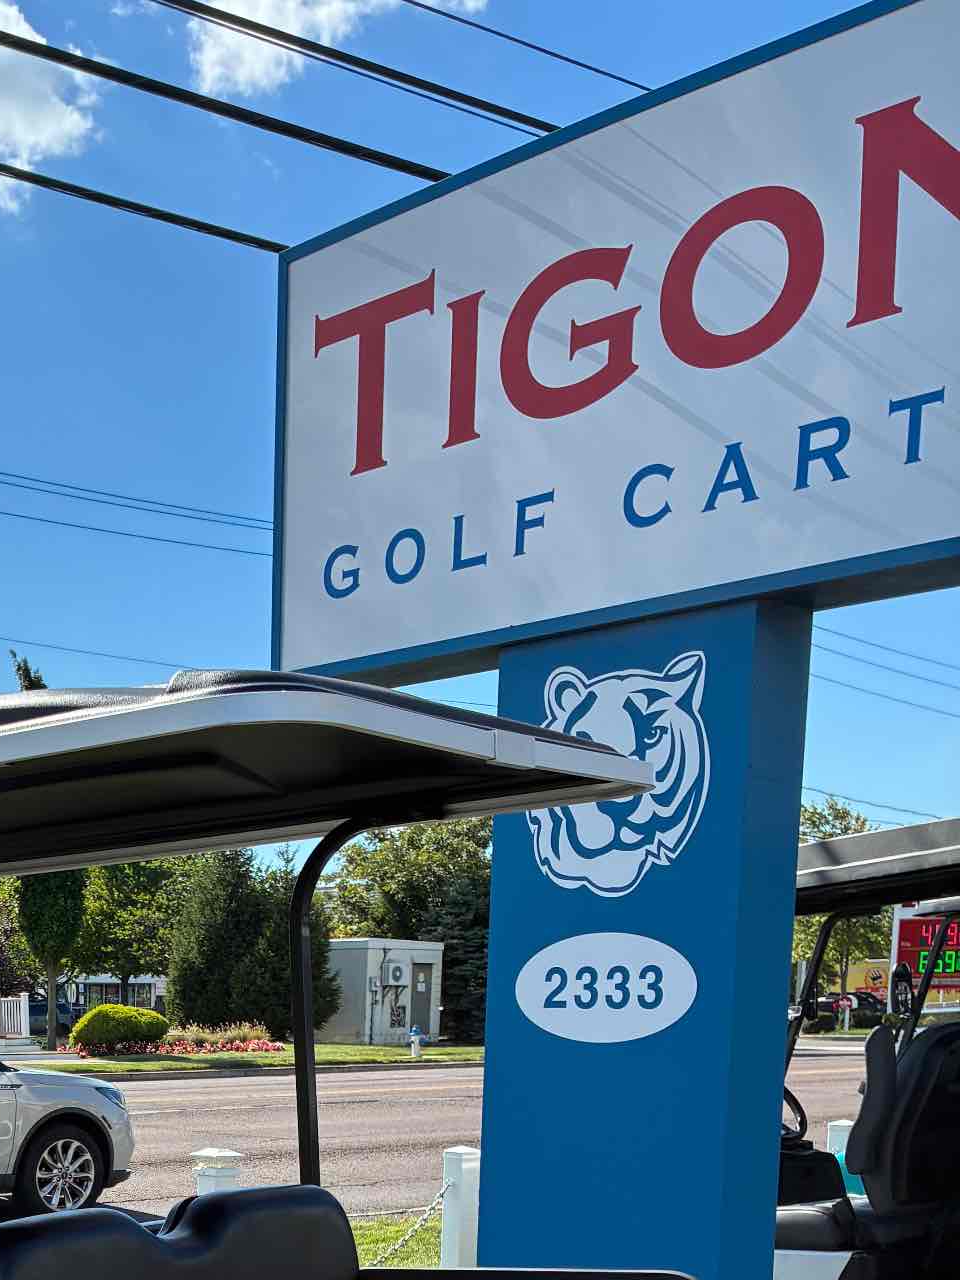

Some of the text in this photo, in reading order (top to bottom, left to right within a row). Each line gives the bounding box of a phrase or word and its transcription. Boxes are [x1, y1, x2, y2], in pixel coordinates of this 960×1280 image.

[323, 386, 946, 599] GOLF CART
[543, 963, 664, 1010] 2333
